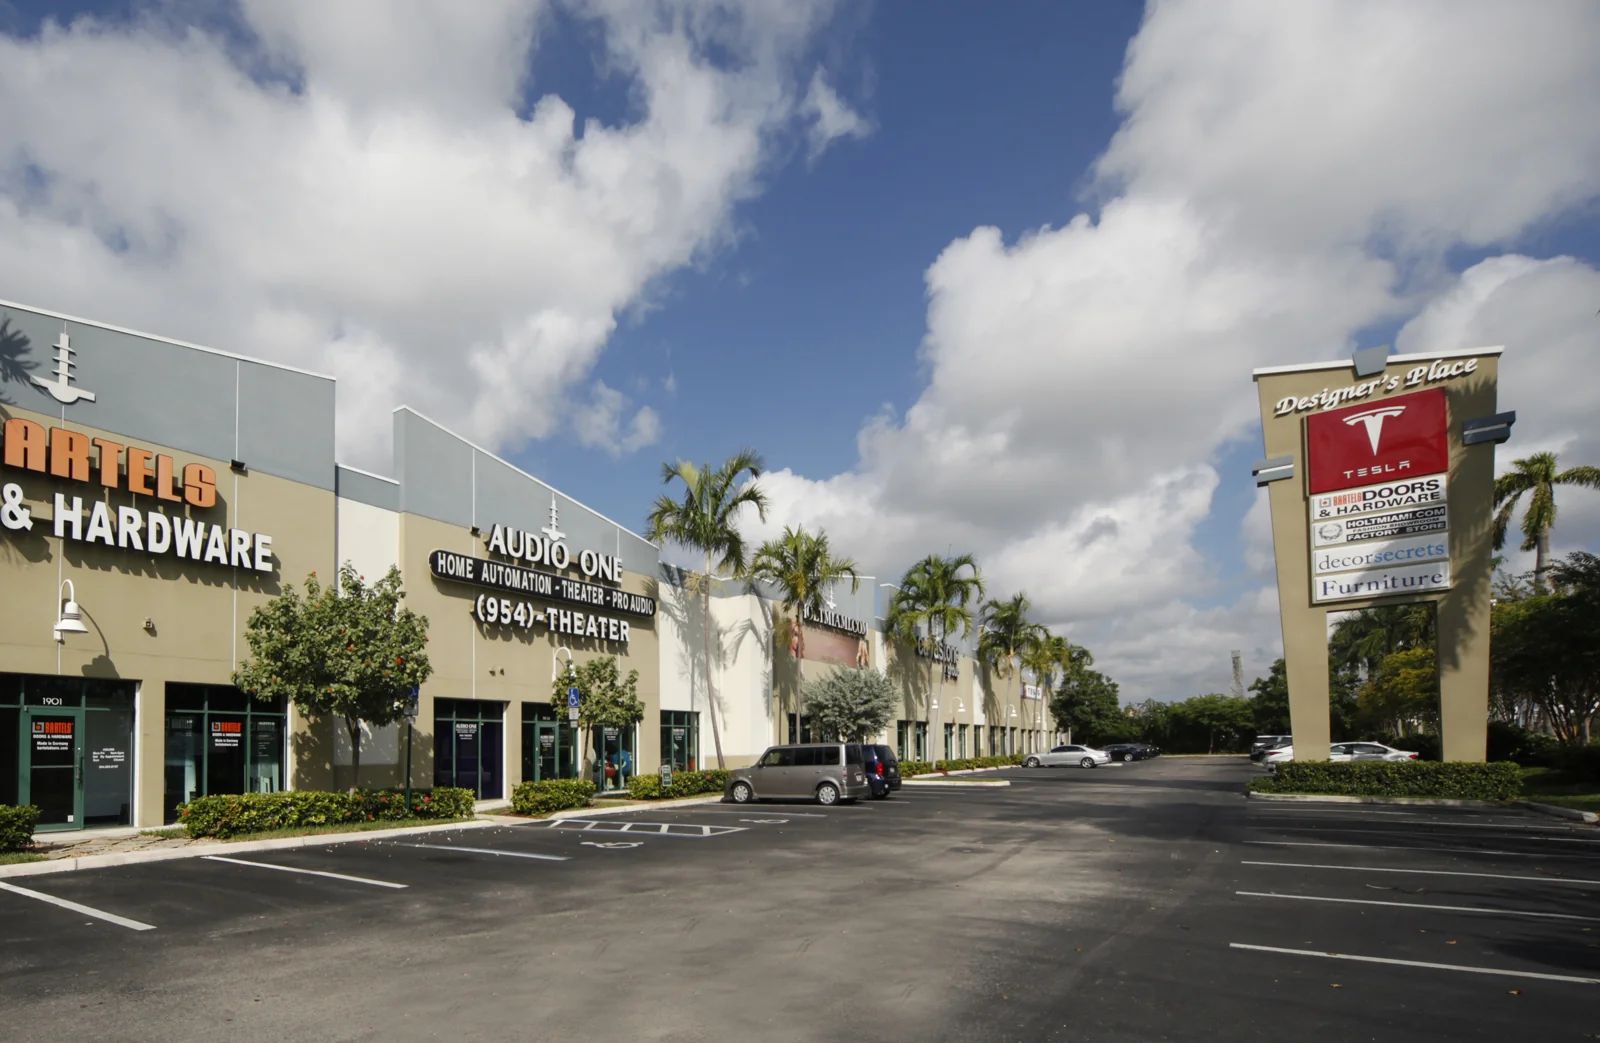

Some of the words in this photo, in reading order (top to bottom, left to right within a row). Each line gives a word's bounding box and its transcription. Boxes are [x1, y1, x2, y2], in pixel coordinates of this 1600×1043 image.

[1276, 374, 1399, 415] Designer's
[1406, 358, 1479, 386] Place
[1343, 461, 1411, 479] TESLA
[1362, 479, 1440, 501] DOORS
[1319, 509, 1331, 518] &
[1337, 491, 1440, 515] HARDWARE
[0, 482, 33, 531] &
[54, 492, 273, 572] HARDWARE
[1347, 508, 1445, 528] HOLTMIAMI.COM
[1352, 525, 1388, 533] FASHION
[1348, 529, 1400, 541] FACTORY
[1405, 522, 1445, 533] STORE
[488, 523, 570, 569] AUDIO
[580, 549, 623, 583] ONE
[1319, 543, 1445, 571] decorsecrets
[437, 551, 474, 580] HOME
[481, 564, 552, 595] AUTOMATION
[562, 580, 604, 606] THEATER
[612, 592, 629, 610] PRO
[630, 596, 654, 616] AUDIO
[1322, 573, 1443, 597] Furniture
[43, 697, 62, 705] 1901
